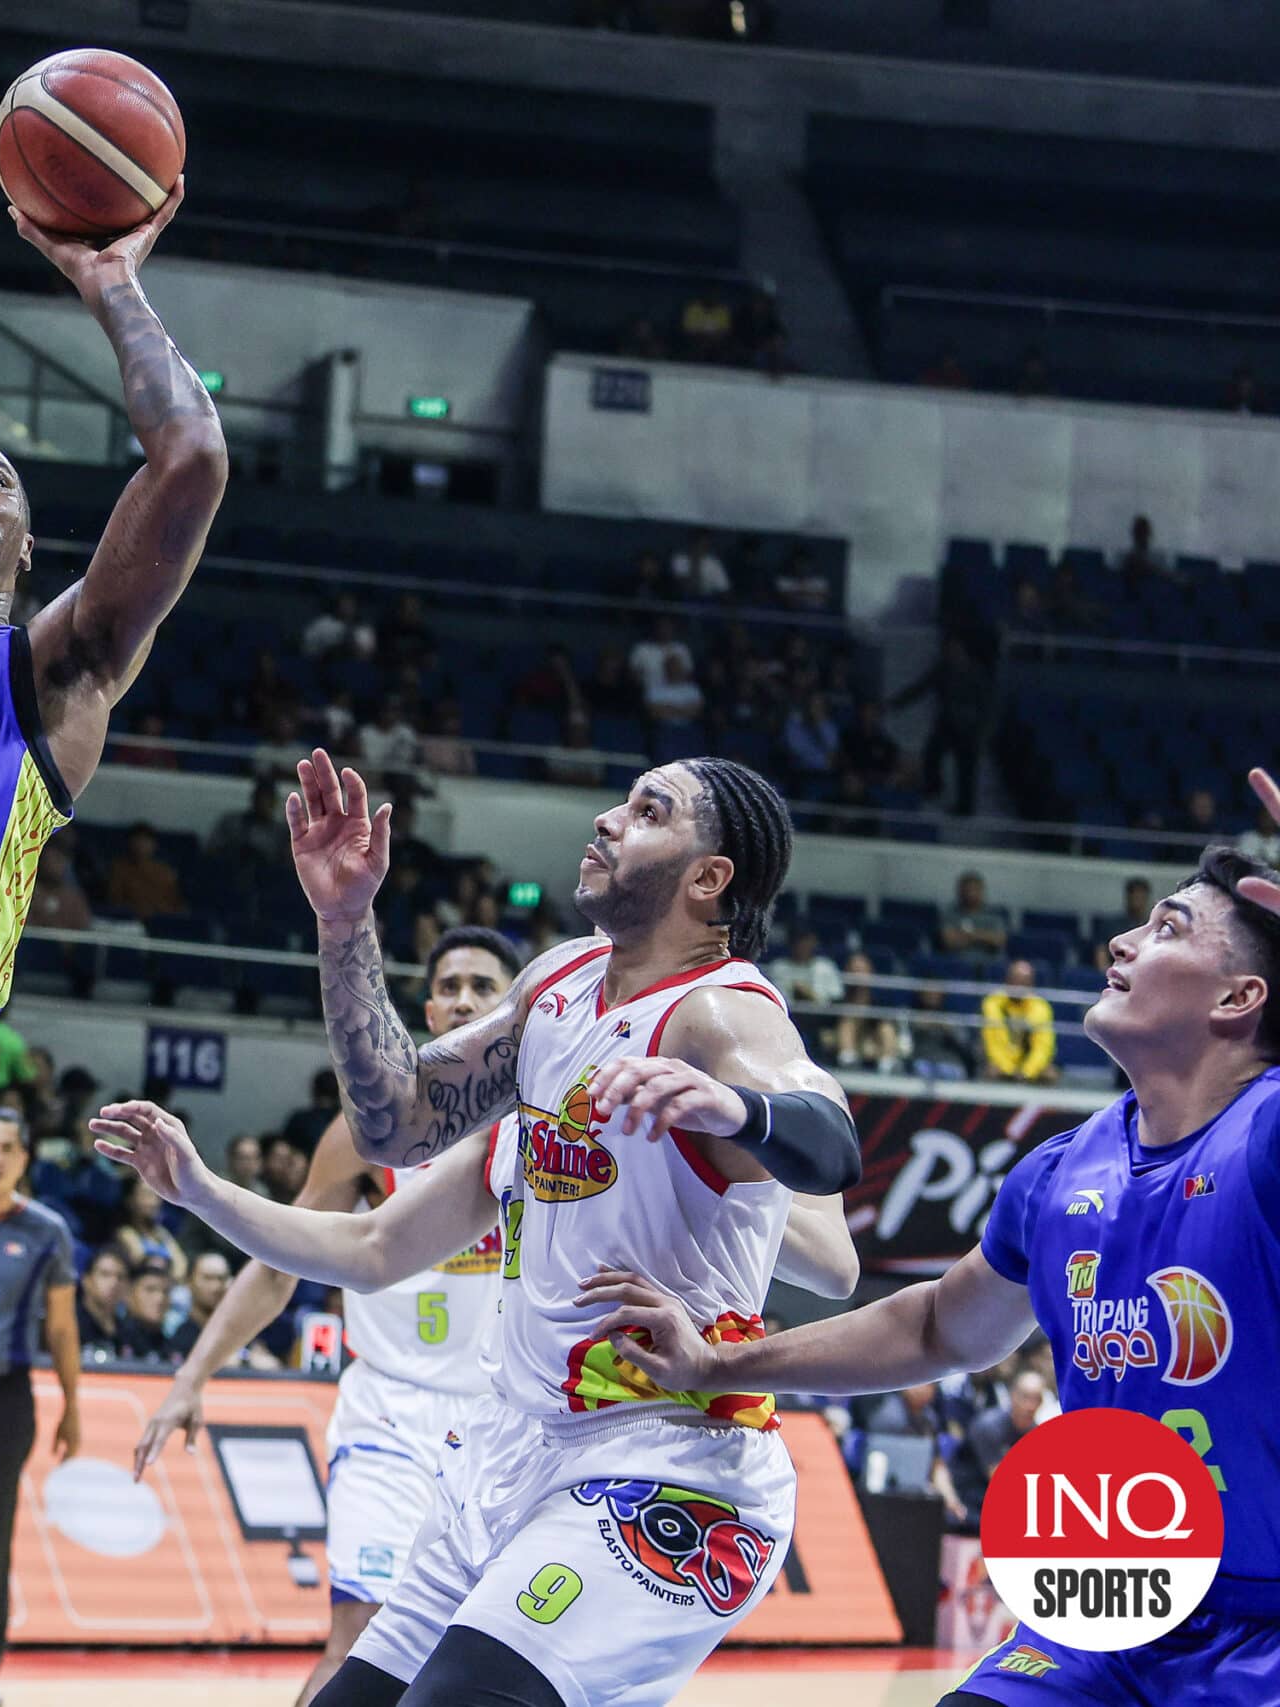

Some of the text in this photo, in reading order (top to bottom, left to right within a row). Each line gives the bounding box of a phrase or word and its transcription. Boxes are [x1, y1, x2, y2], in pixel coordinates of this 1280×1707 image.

[153, 1036, 220, 1082] 116
[531, 1119, 612, 1185] Shine
[876, 1128, 1017, 1239] Pi
[1066, 1201, 1090, 1215] ANTA
[417, 1292, 449, 1344] 5
[516, 1562, 584, 1625] 9
[597, 1518, 696, 1607] ELASTO PAINTERS
